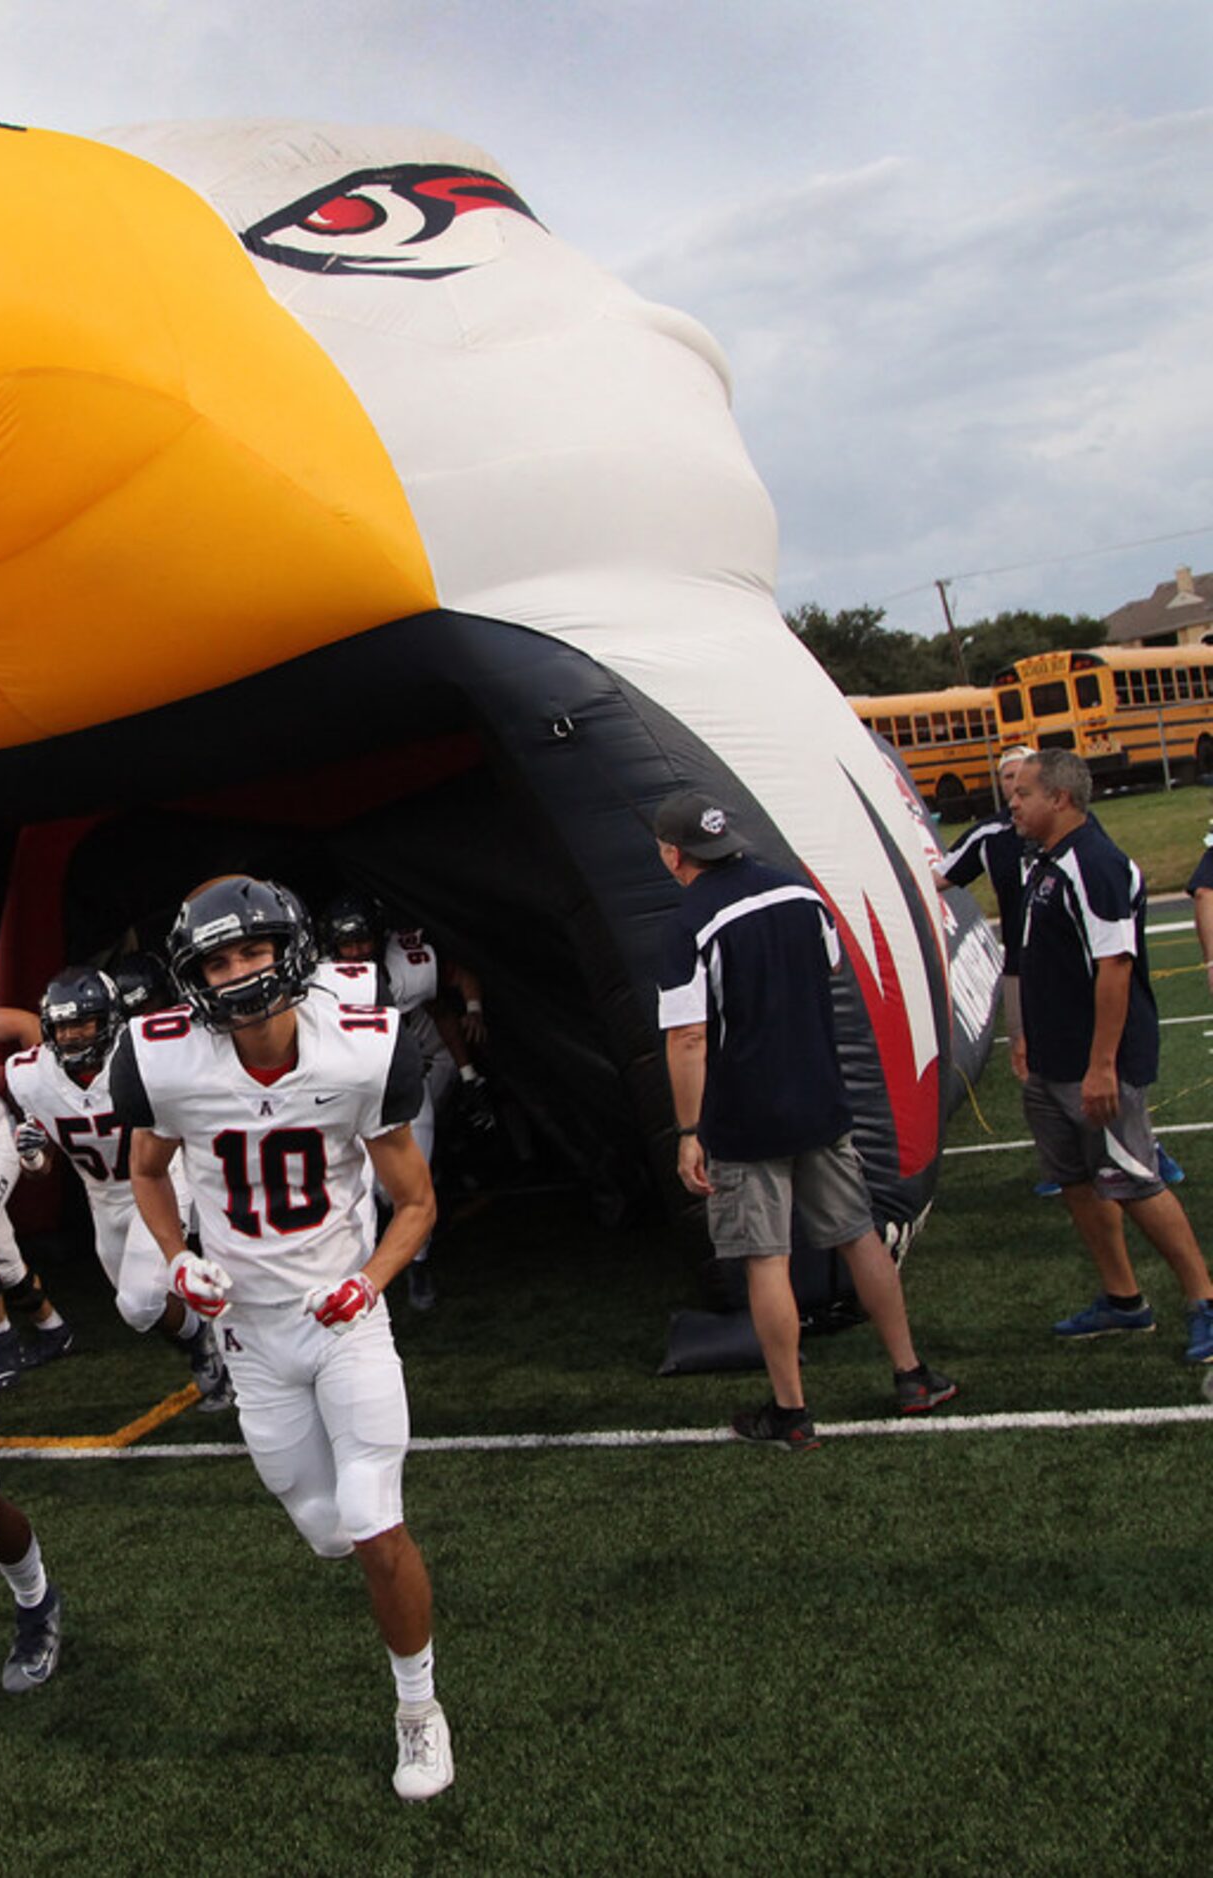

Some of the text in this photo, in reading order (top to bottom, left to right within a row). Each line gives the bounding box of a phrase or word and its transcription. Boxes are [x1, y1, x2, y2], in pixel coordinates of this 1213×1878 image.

[339, 1003, 388, 1034] 10
[259, 1100, 274, 1116] A
[55, 1112, 131, 1182] 57
[212, 1127, 331, 1239] 10
[222, 1327, 244, 1352] A
